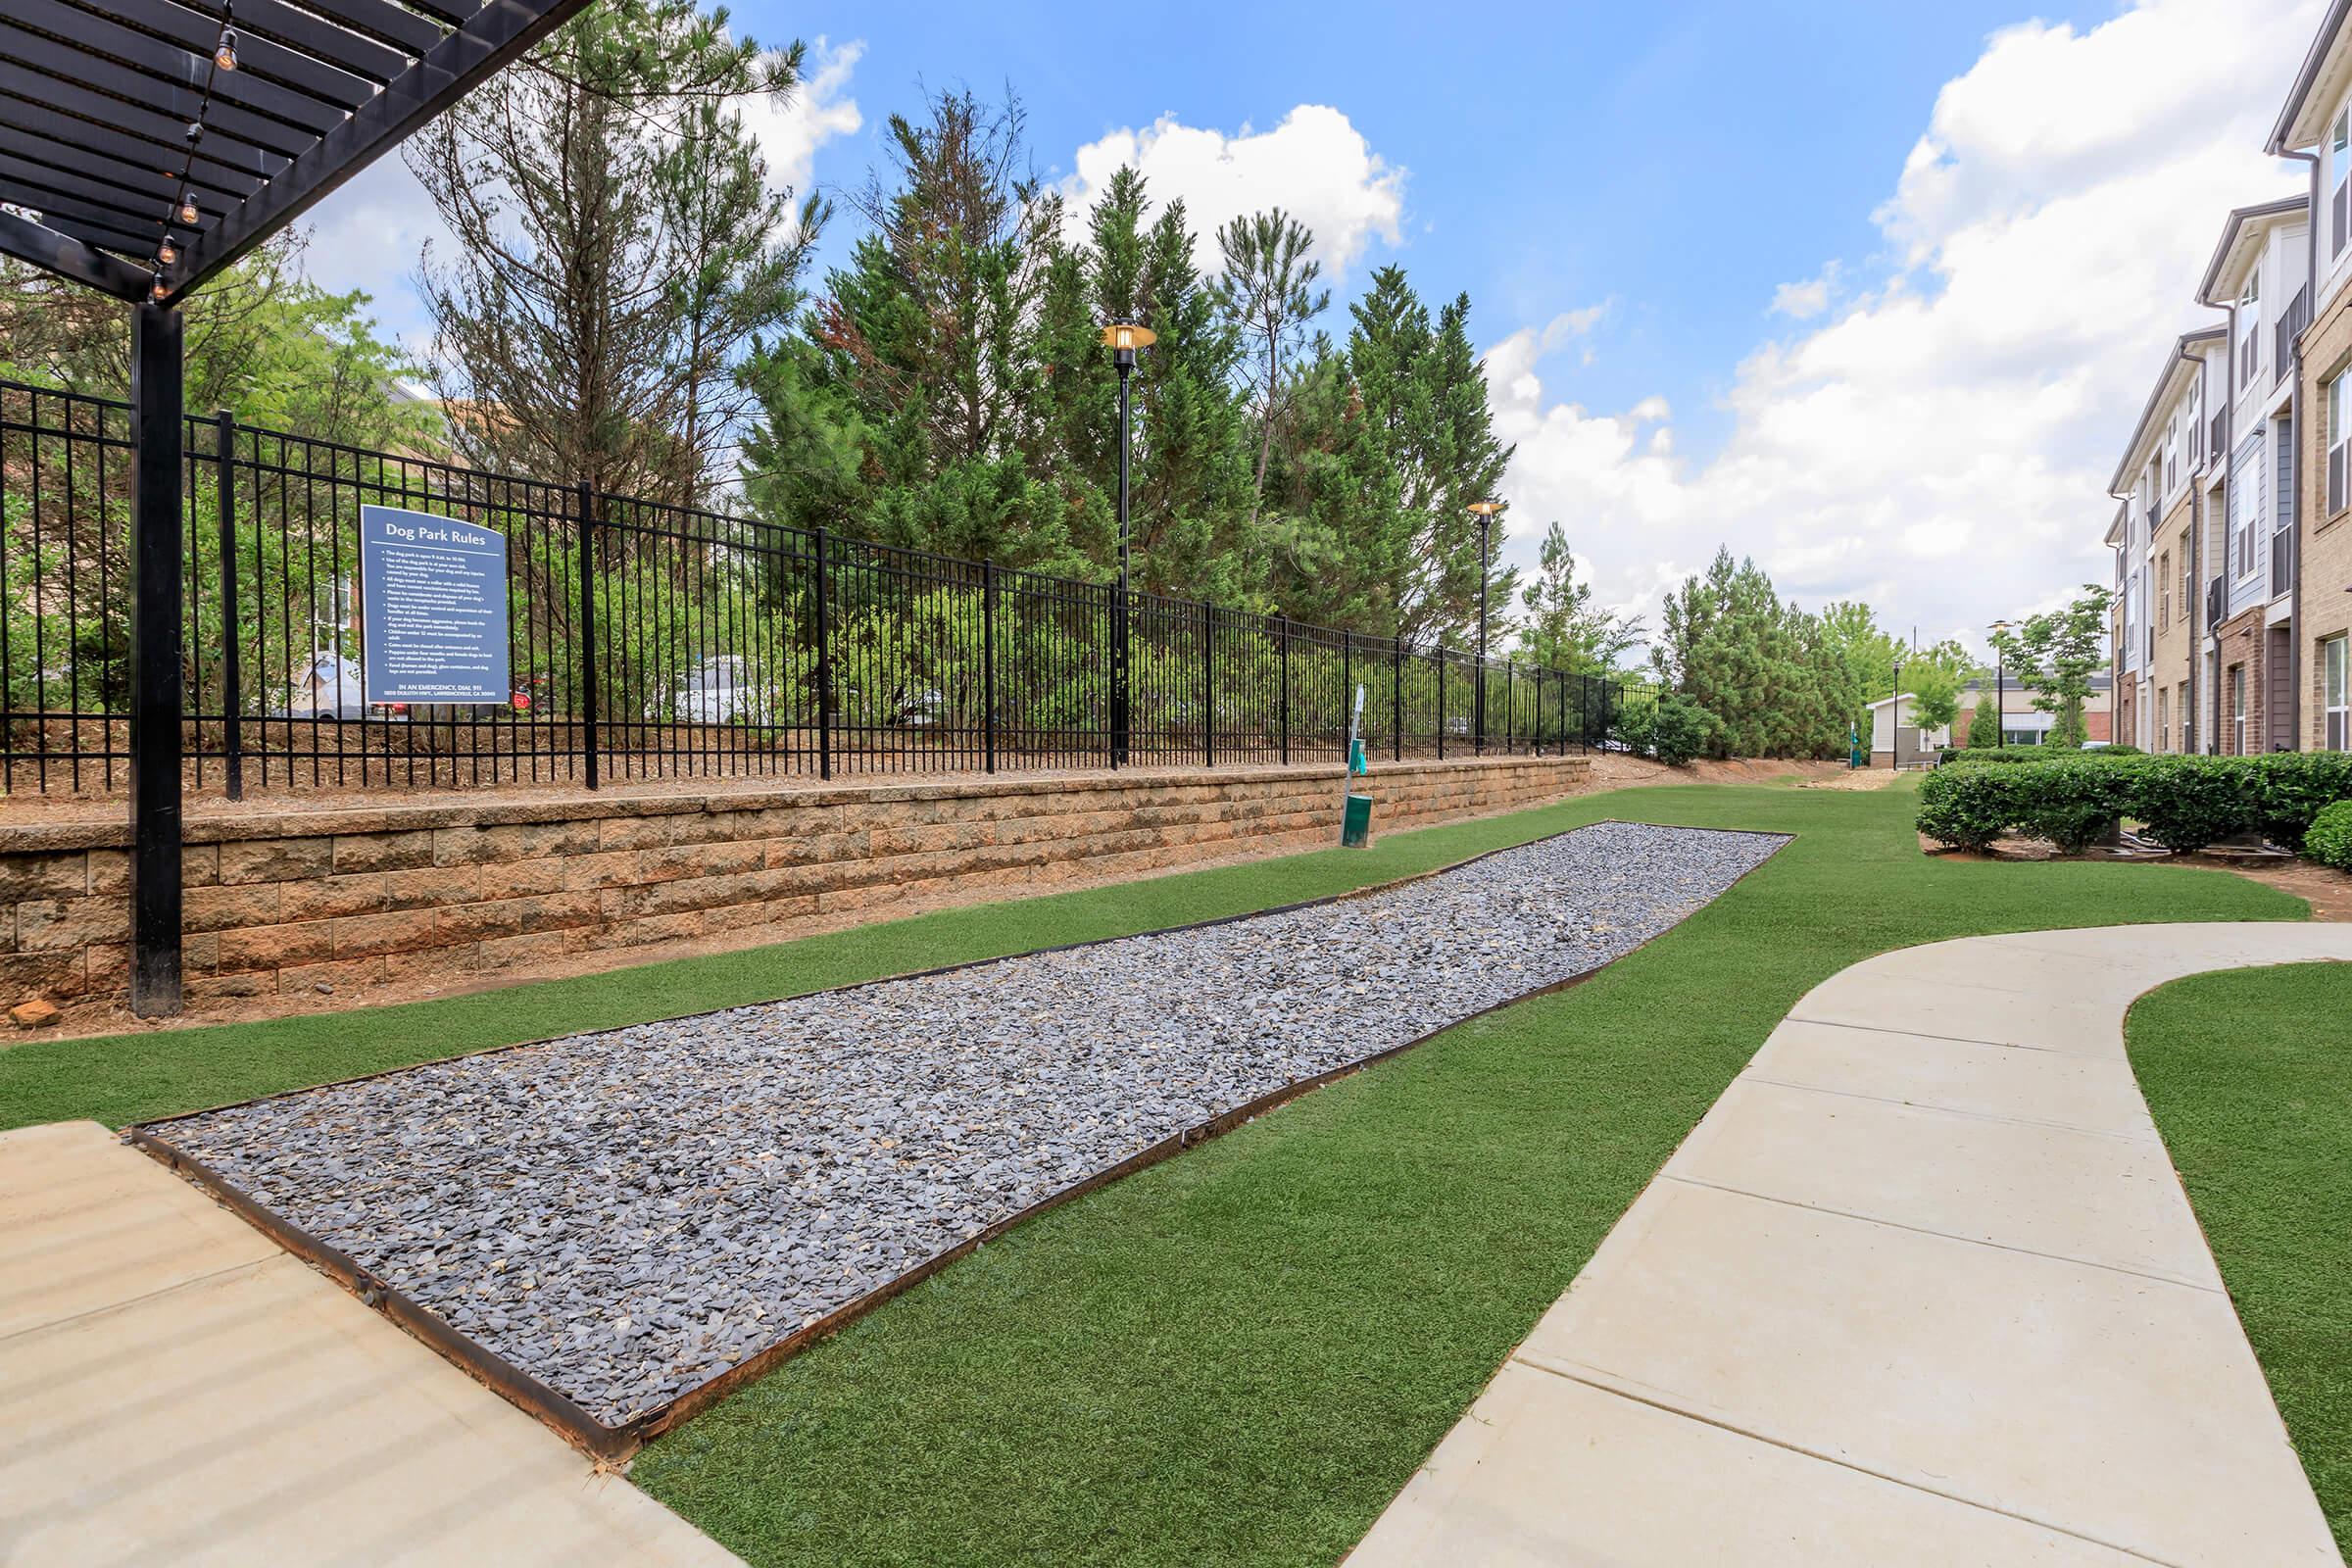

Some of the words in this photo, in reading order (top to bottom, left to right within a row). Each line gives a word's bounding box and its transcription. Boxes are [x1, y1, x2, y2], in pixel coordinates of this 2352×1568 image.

[386, 523, 415, 541] Dog
[418, 527, 448, 542] Park
[452, 531, 486, 546] Rules
